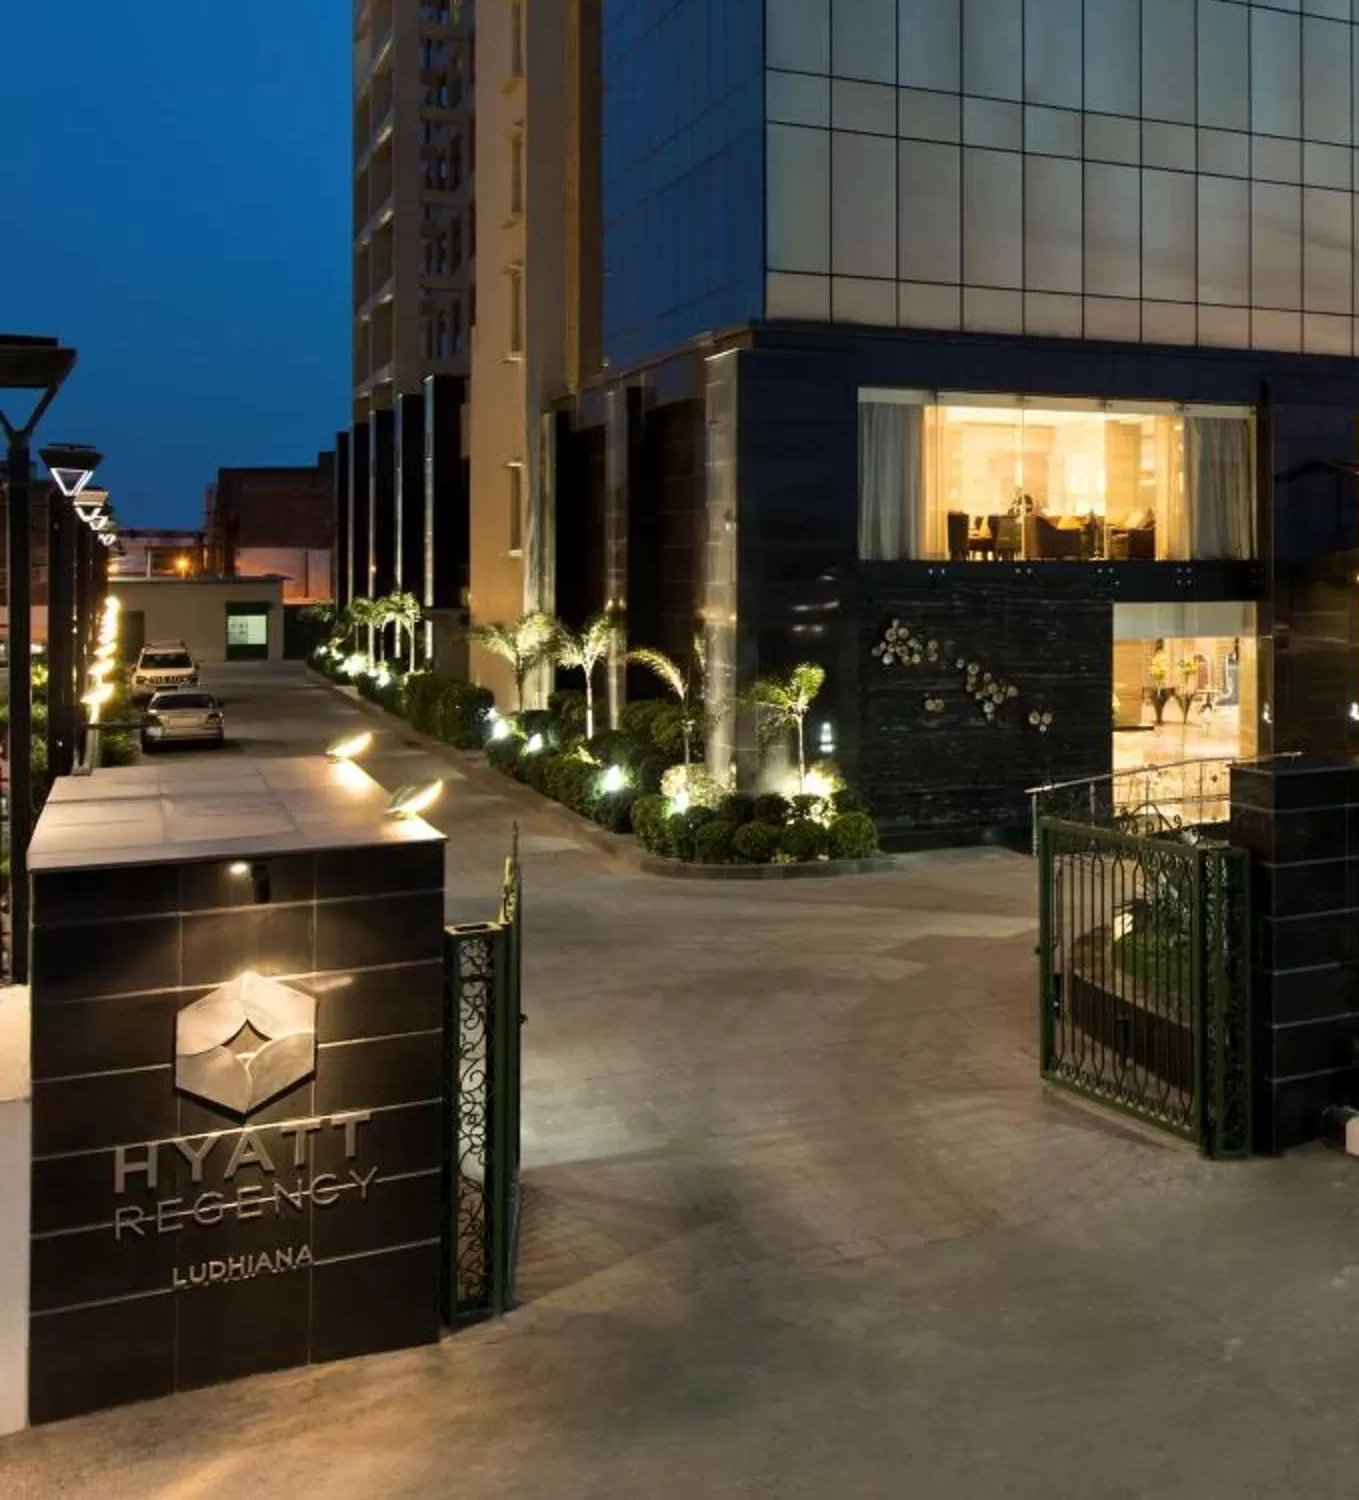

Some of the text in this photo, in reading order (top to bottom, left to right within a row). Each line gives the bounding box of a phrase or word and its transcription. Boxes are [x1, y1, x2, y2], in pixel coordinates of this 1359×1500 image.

[114, 1111, 371, 1193] HYATT
[115, 1165, 378, 1240] REGENCY
[172, 1244, 314, 1286] LUDHIANA
